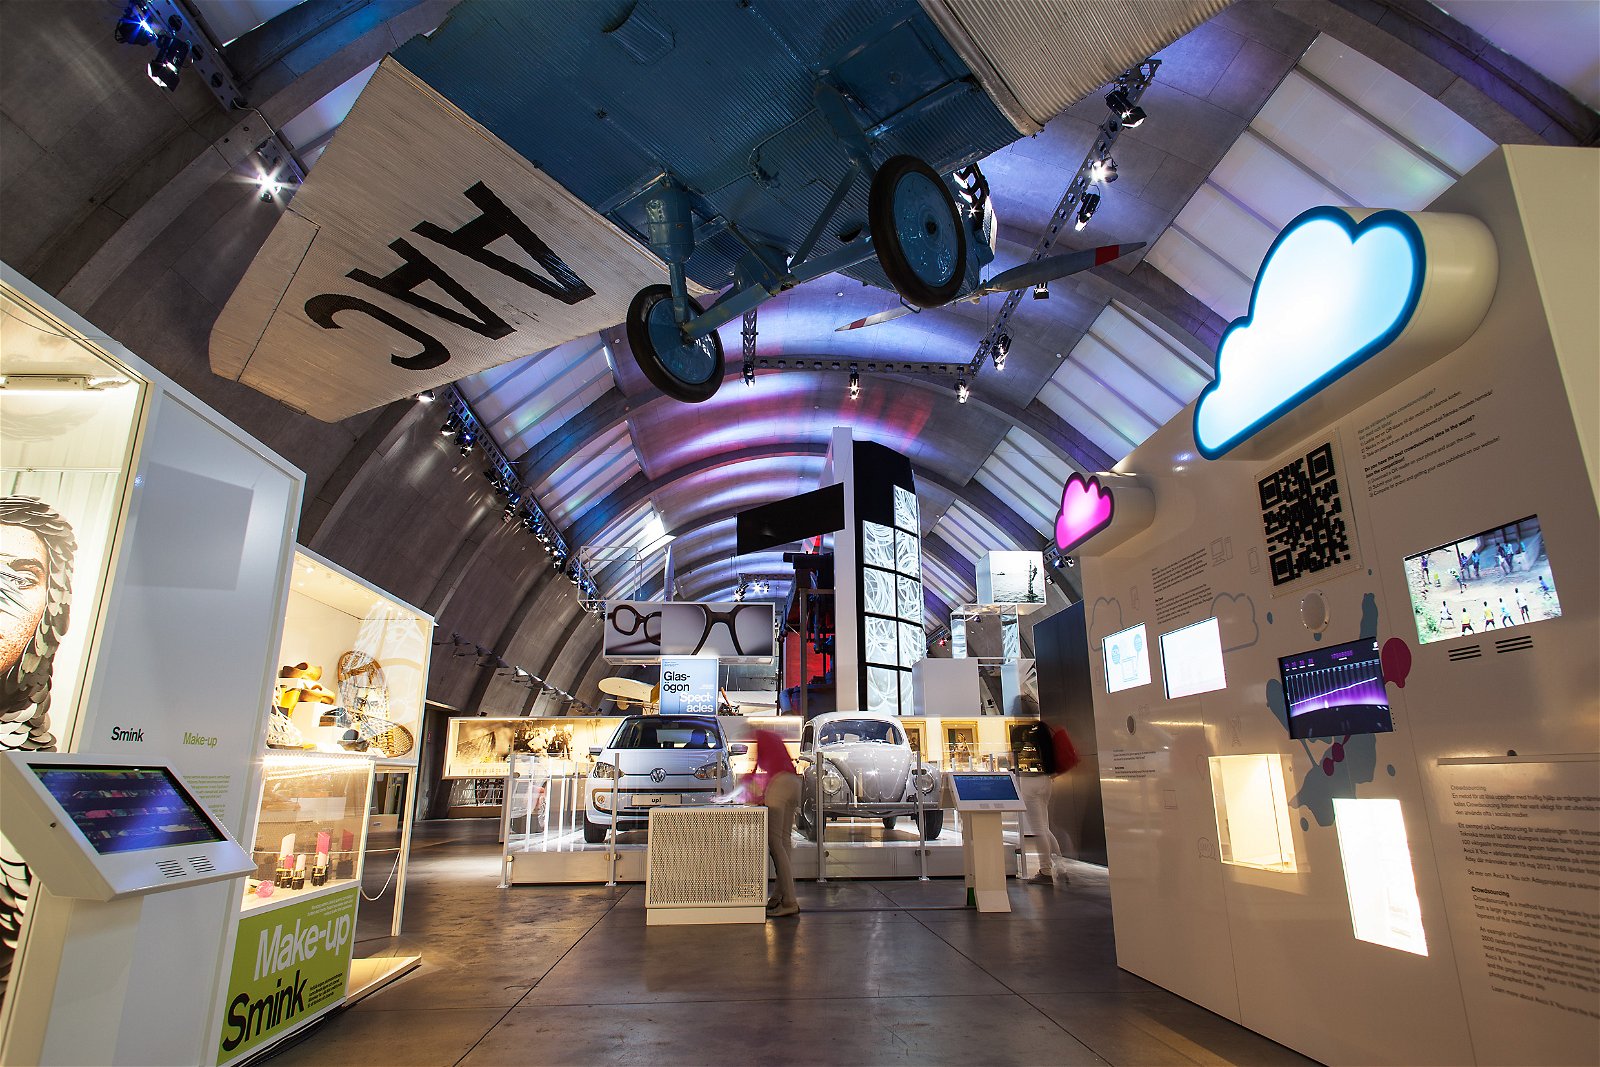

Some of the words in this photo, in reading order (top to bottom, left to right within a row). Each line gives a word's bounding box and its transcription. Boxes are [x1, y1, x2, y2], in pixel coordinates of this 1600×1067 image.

[304, 180, 596, 371] AAC
[1459, 415, 1475, 427] world?
[663, 671, 690, 681] Glas-
[663, 681, 690, 694] ögon
[679, 692, 714, 704] Spect-
[686, 702, 714, 713] acles
[111, 726, 144, 742] Smink
[183, 732, 218, 748] Make-up
[651, 796, 662, 804] up!
[254, 913, 350, 982] Make-up
[222, 969, 308, 1051] Smink
